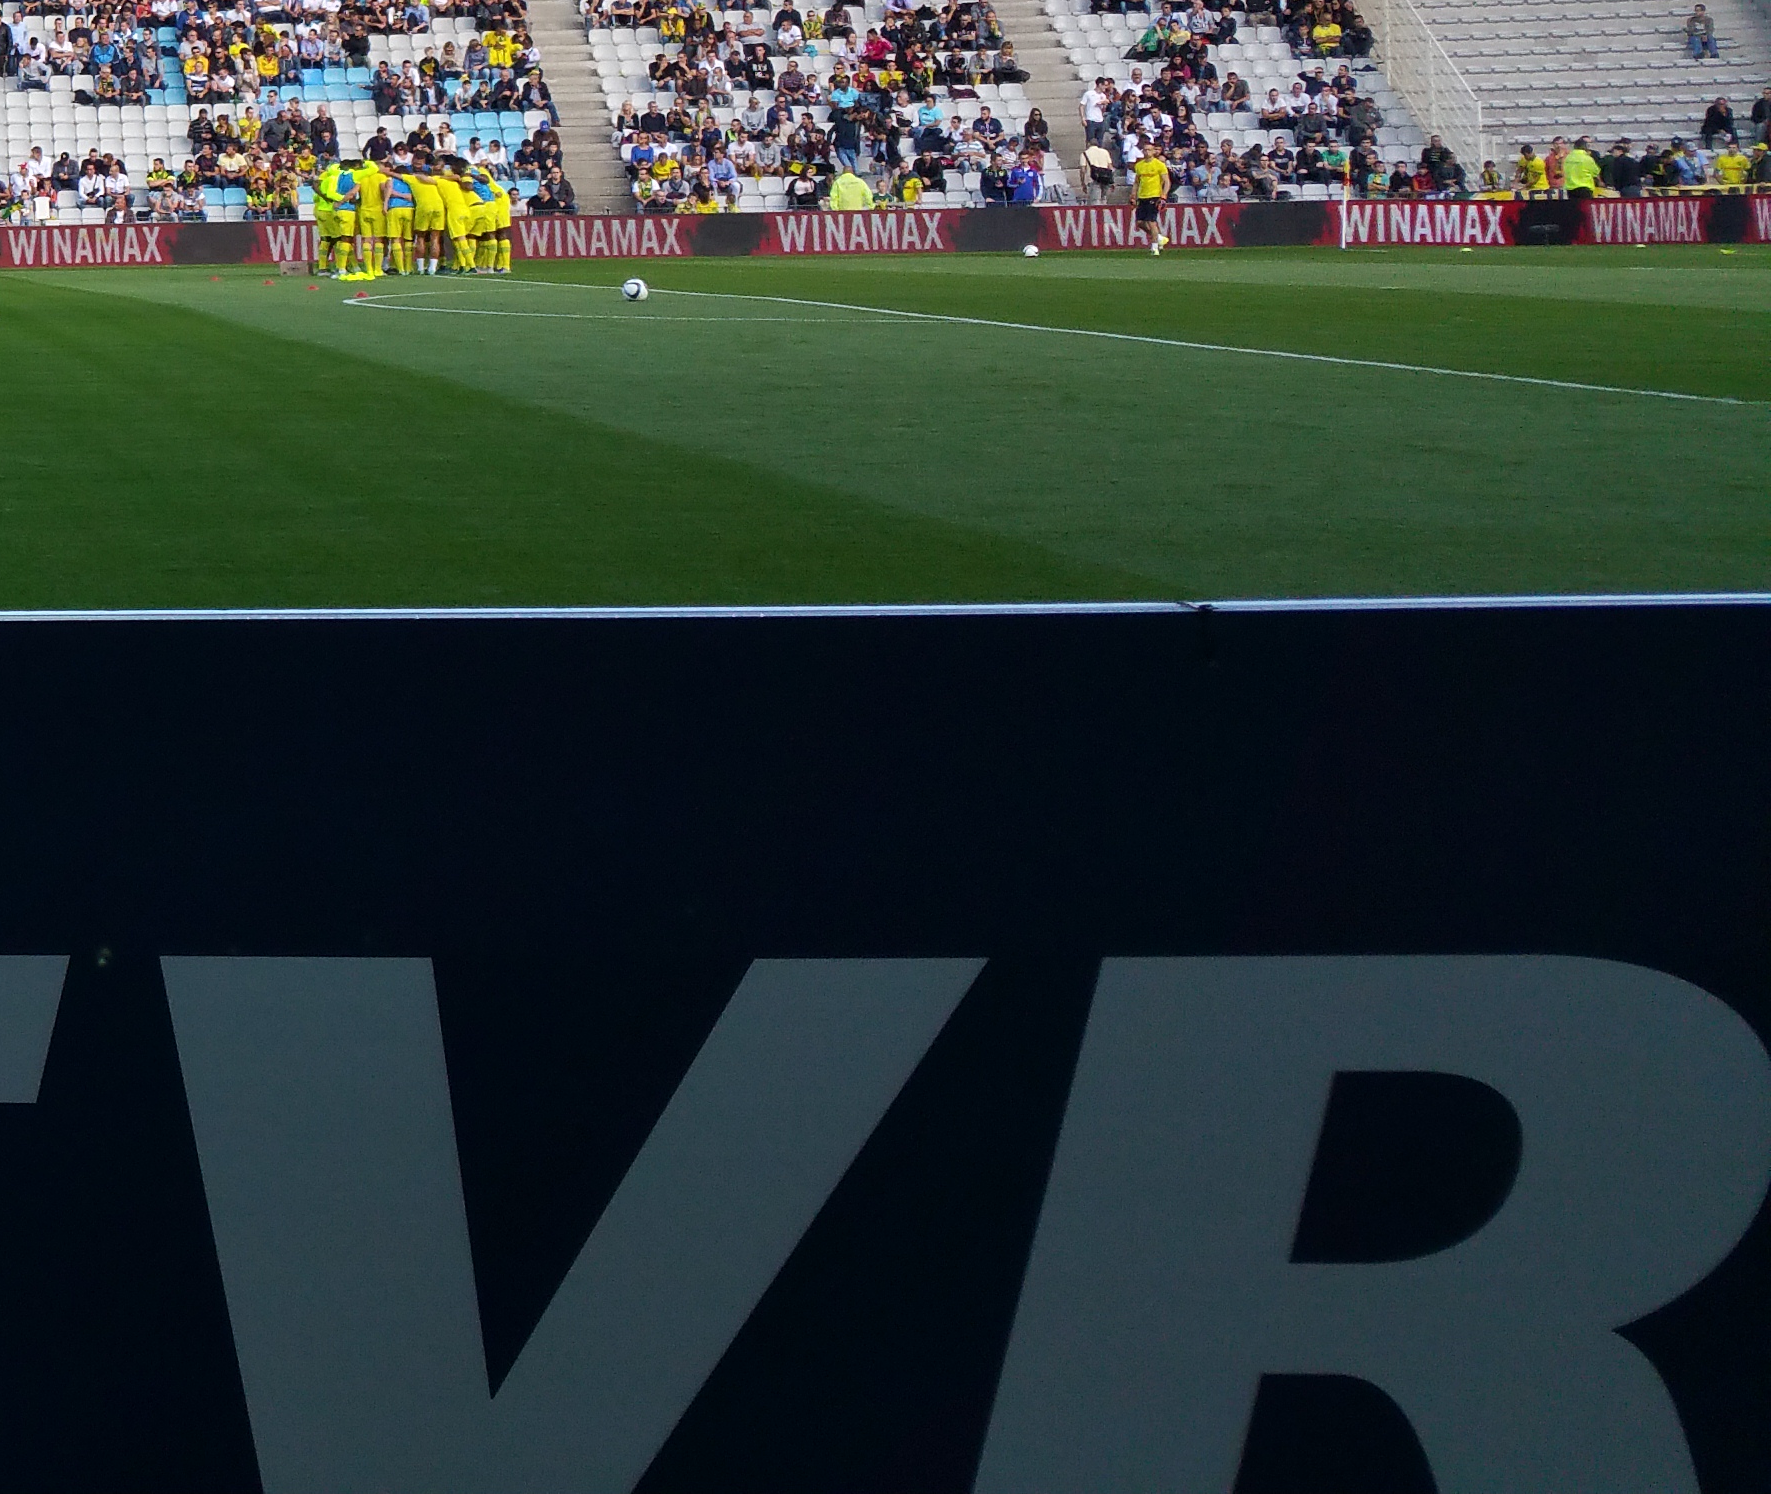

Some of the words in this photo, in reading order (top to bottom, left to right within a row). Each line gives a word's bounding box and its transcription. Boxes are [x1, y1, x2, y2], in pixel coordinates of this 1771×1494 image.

[519, 218, 683, 257] WINAMAX
[775, 212, 944, 252] WINAMAX
[1338, 203, 1506, 244] WINAMAX
[1590, 200, 1703, 243] WINAMAX
[8, 226, 162, 266] WINAMAX
